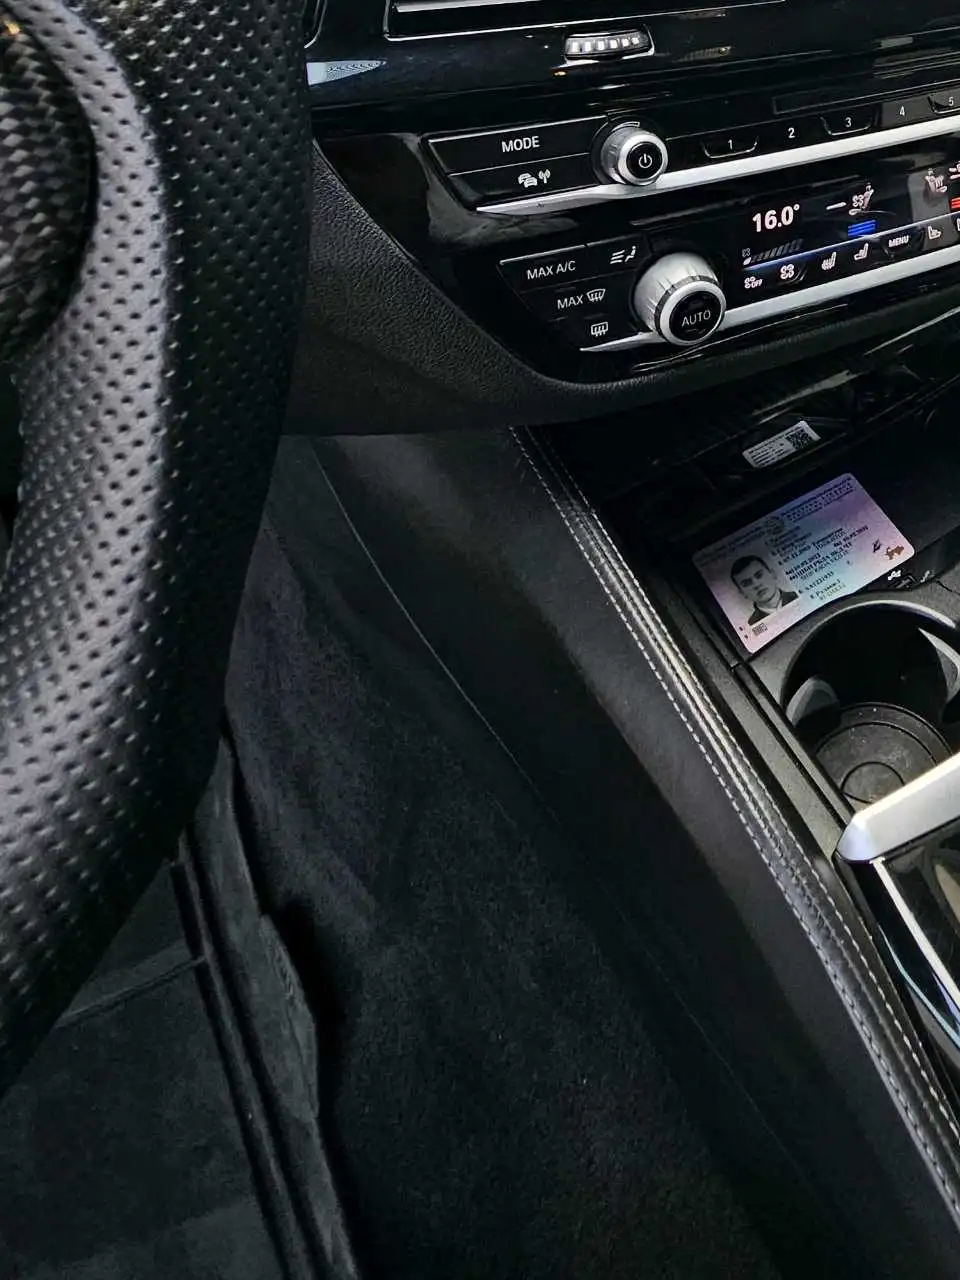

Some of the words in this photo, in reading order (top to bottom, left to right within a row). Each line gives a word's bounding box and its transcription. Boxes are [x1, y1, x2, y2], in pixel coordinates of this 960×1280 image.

[948, 96, 954, 107] 5
[900, 105, 906, 117] 4
[845, 117, 852, 128] 3
[787, 127, 795, 139] 2
[501, 135, 540, 153] MODE
[727, 139, 733, 150] 1
[752, 203, 800, 232] 16.0°
[888, 235, 910, 248] MENU
[526, 264, 554, 280] MAX
[556, 260, 576, 274] A/C
[557, 294, 584, 310] MAX
[681, 309, 711, 327] AUTO
